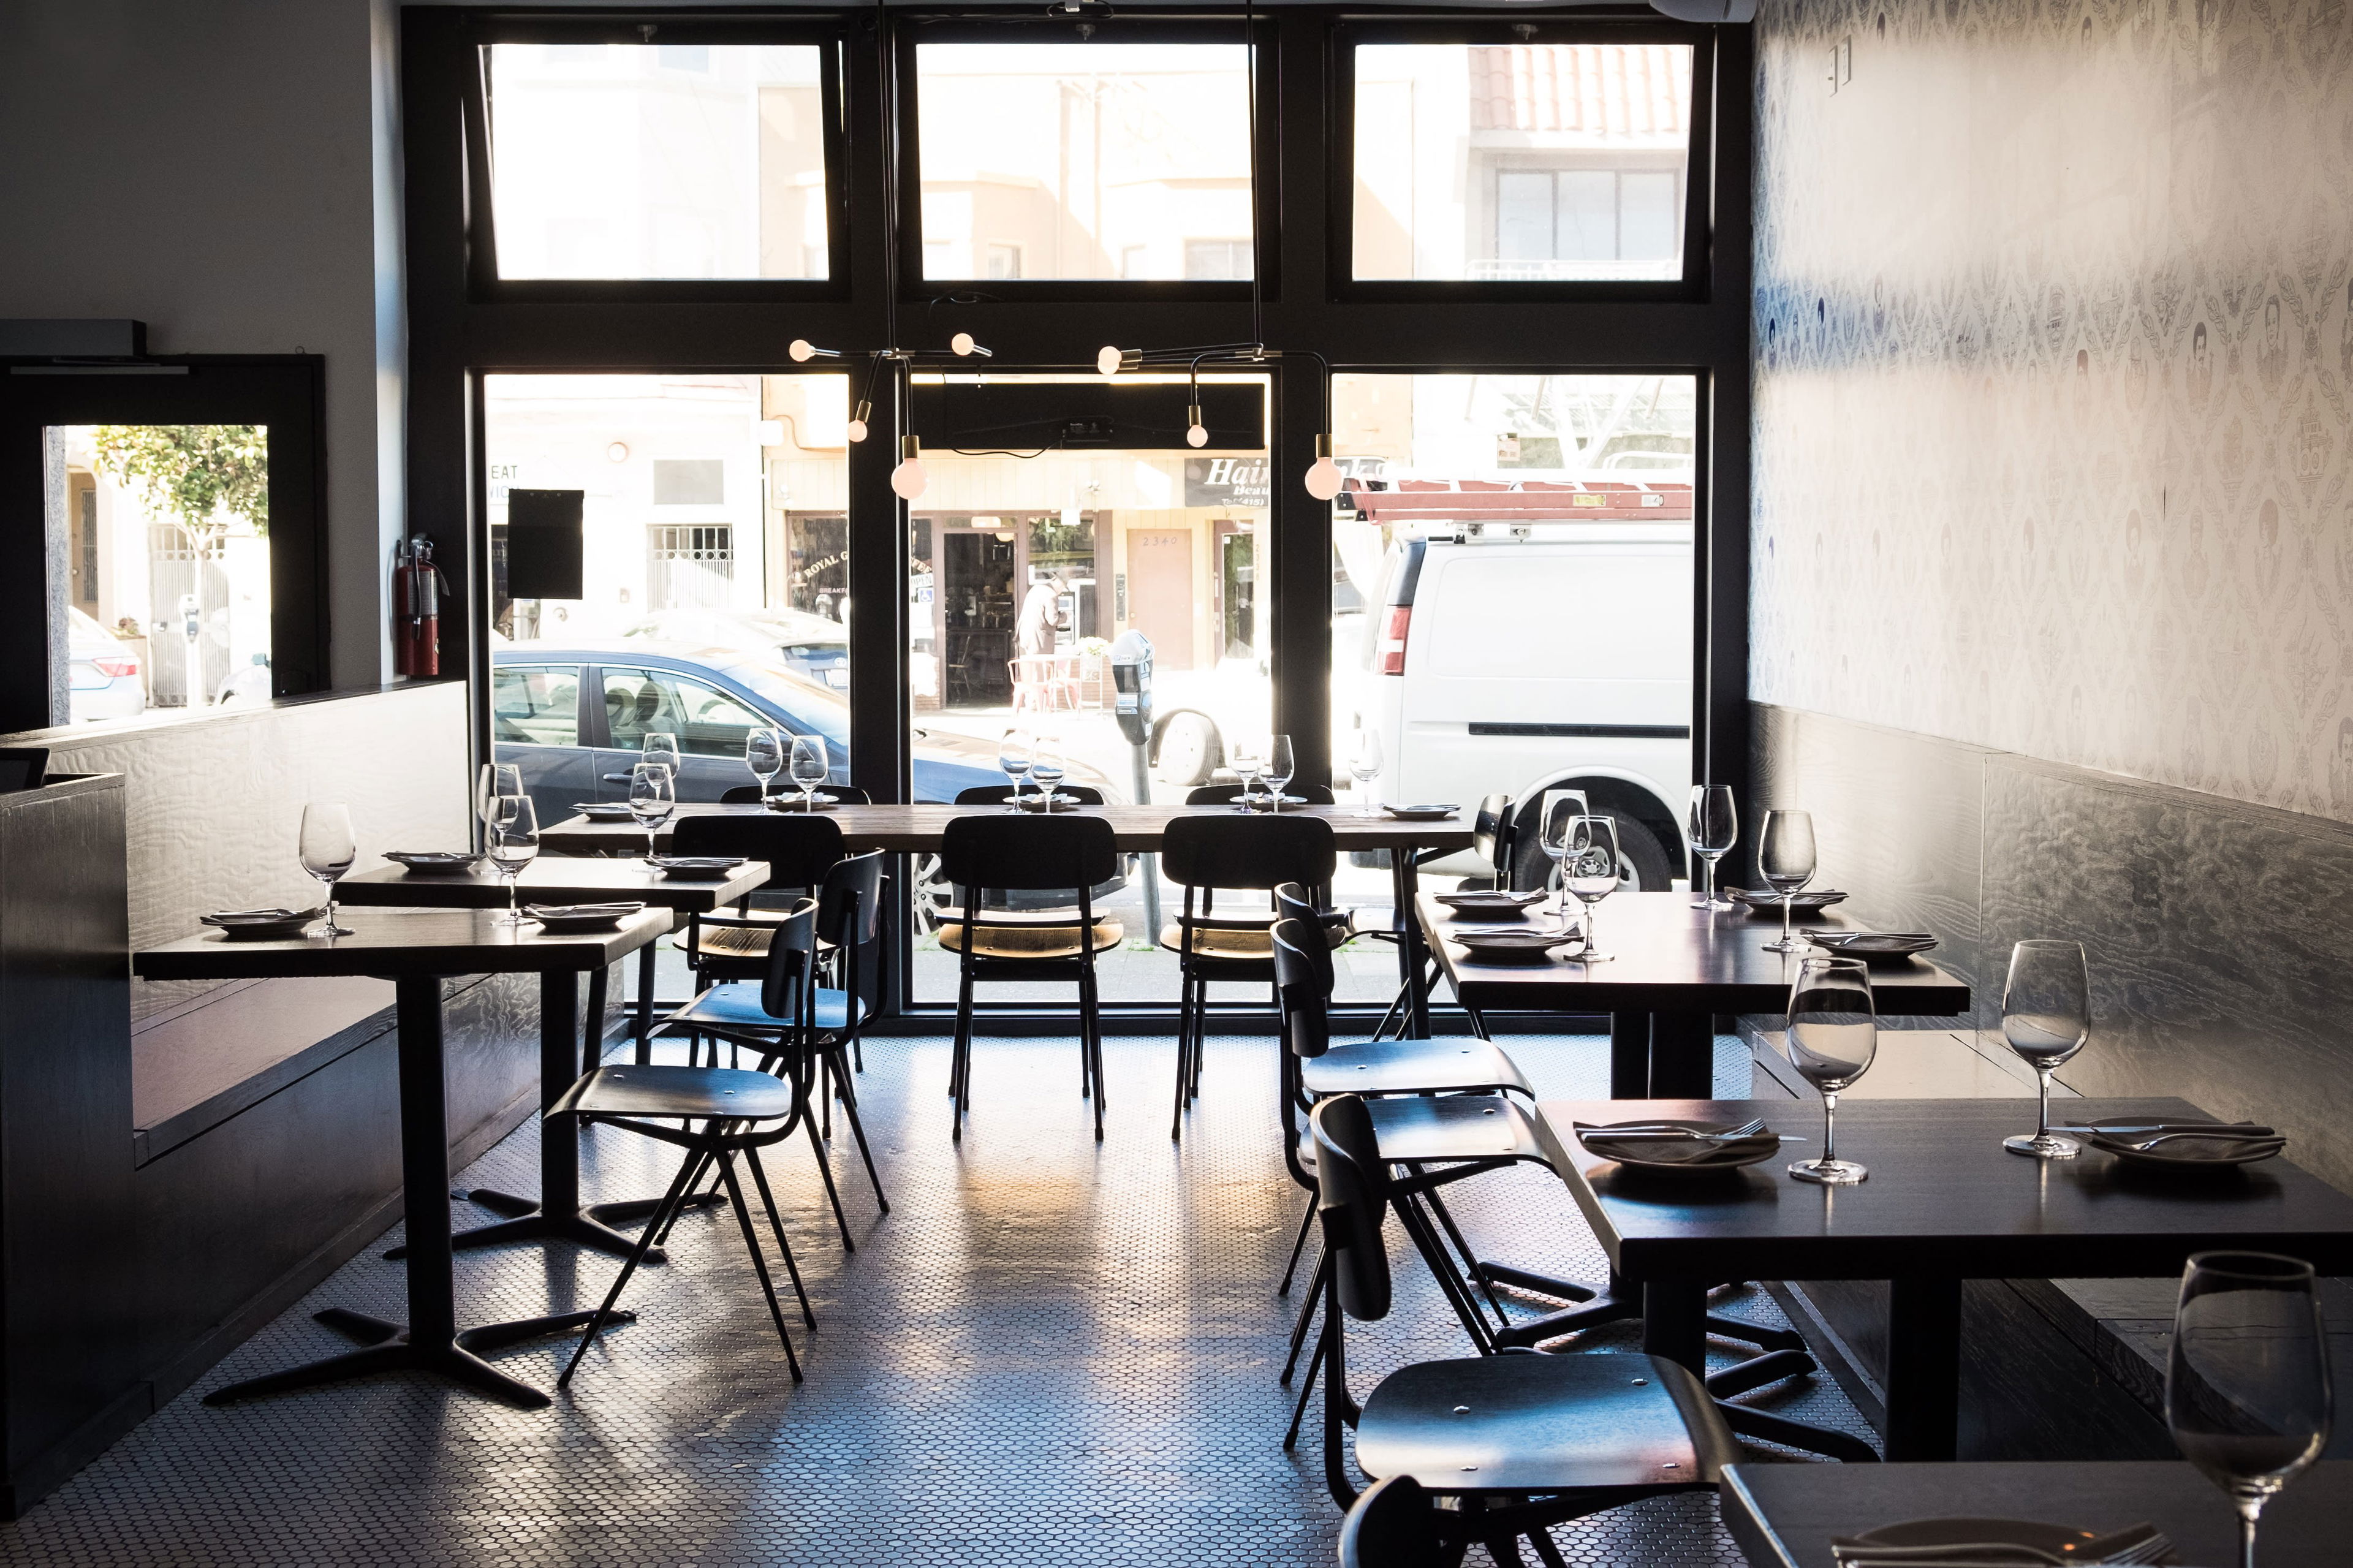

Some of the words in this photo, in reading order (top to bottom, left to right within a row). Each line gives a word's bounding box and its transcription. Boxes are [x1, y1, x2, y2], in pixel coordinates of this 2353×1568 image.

[491, 465, 518, 479] EAT
[1143, 537, 1178, 547] 2340
[804, 554, 839, 578] ROYAL
